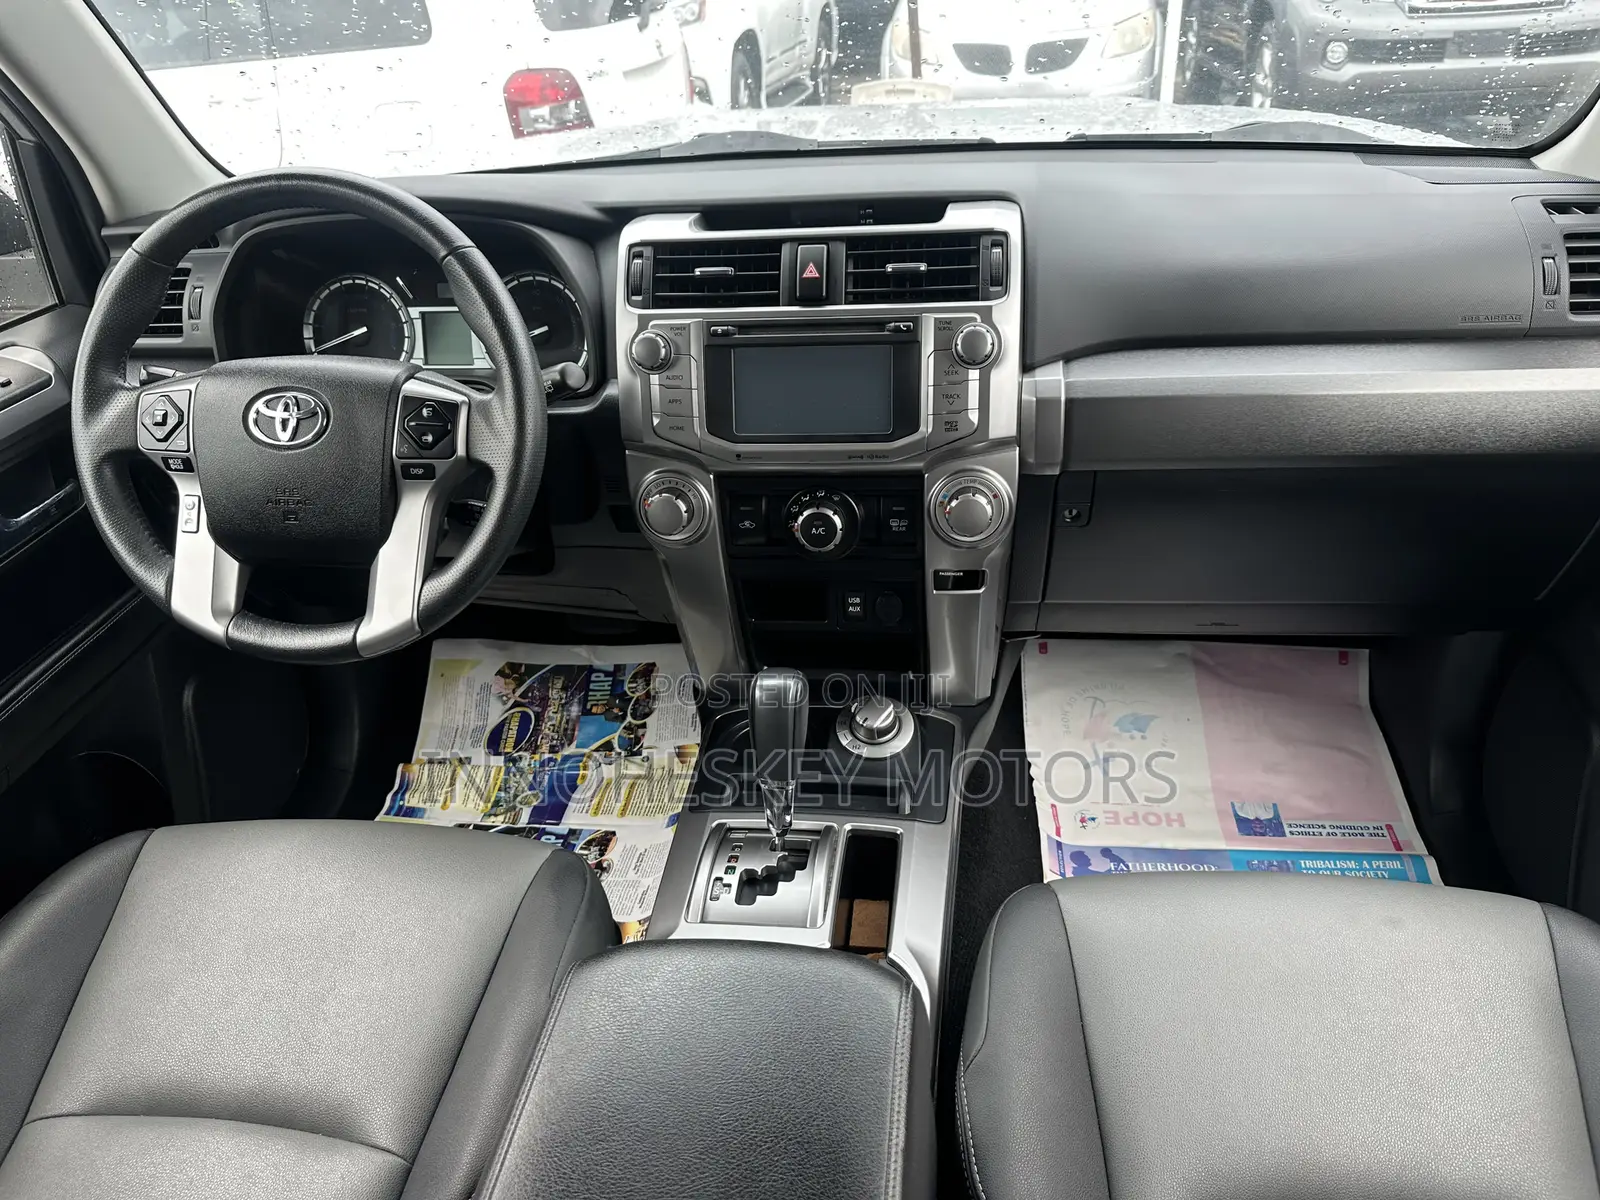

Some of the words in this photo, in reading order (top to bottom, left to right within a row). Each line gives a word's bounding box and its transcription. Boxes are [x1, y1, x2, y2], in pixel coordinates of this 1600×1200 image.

[410, 467, 425, 475] DISP
[811, 527, 826, 535] A/C
[1102, 810, 1186, 828] HOPE
[1299, 860, 1359, 869] TRIBALISM:
[1362, 860, 1369, 869] A
[1374, 860, 1404, 870] PERIL
[1344, 870, 1389, 879] SOCIETY
